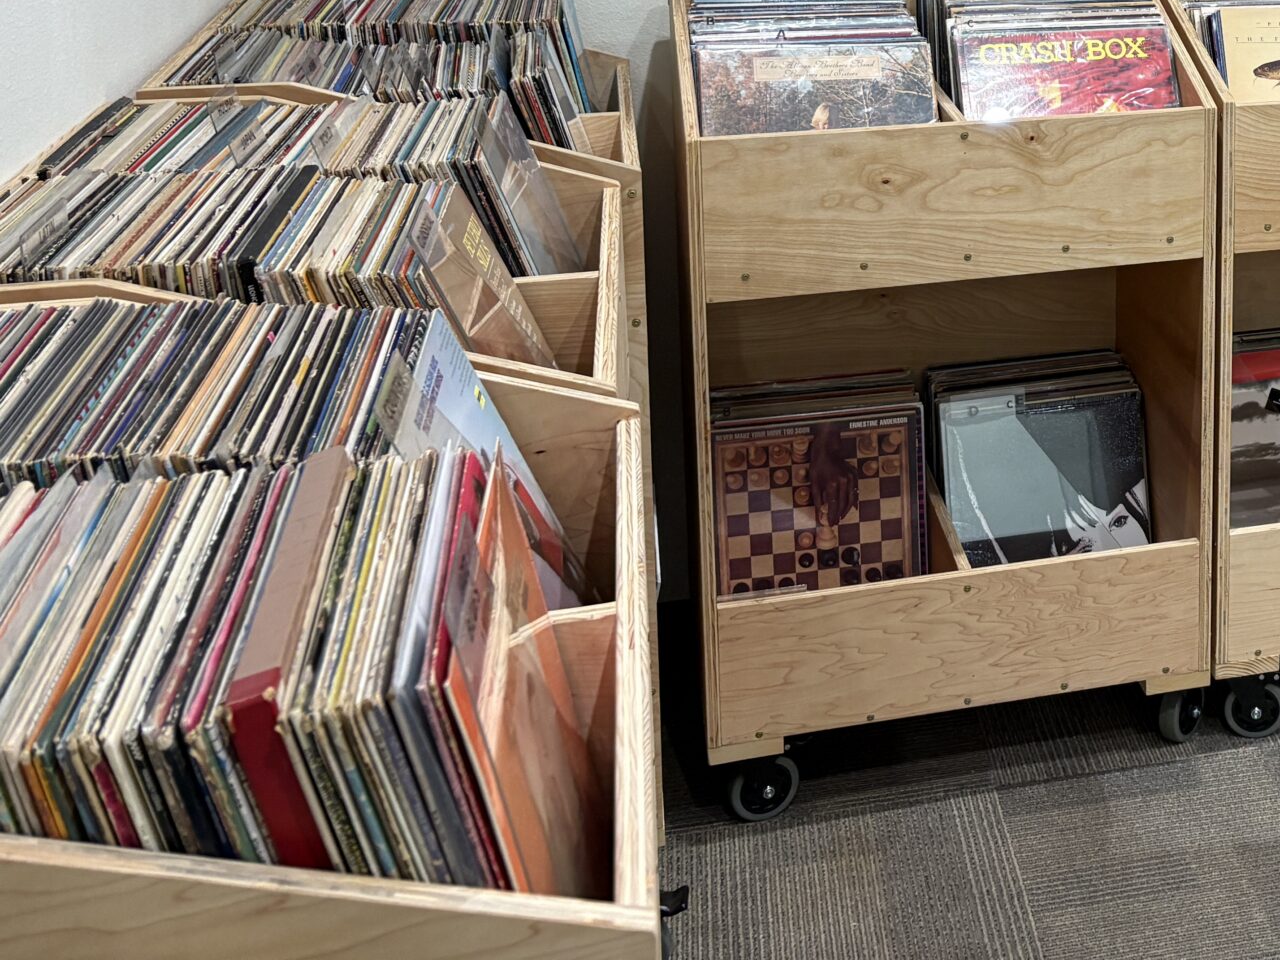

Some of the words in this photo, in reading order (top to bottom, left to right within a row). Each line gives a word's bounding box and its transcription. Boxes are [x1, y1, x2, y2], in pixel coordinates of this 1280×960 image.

[706, 16, 715, 25] B
[776, 29, 787, 40] A
[979, 41, 1075, 65] CRASH
[1086, 37, 1149, 62] BOX
[850, 420, 878, 429] ERNESTINE
